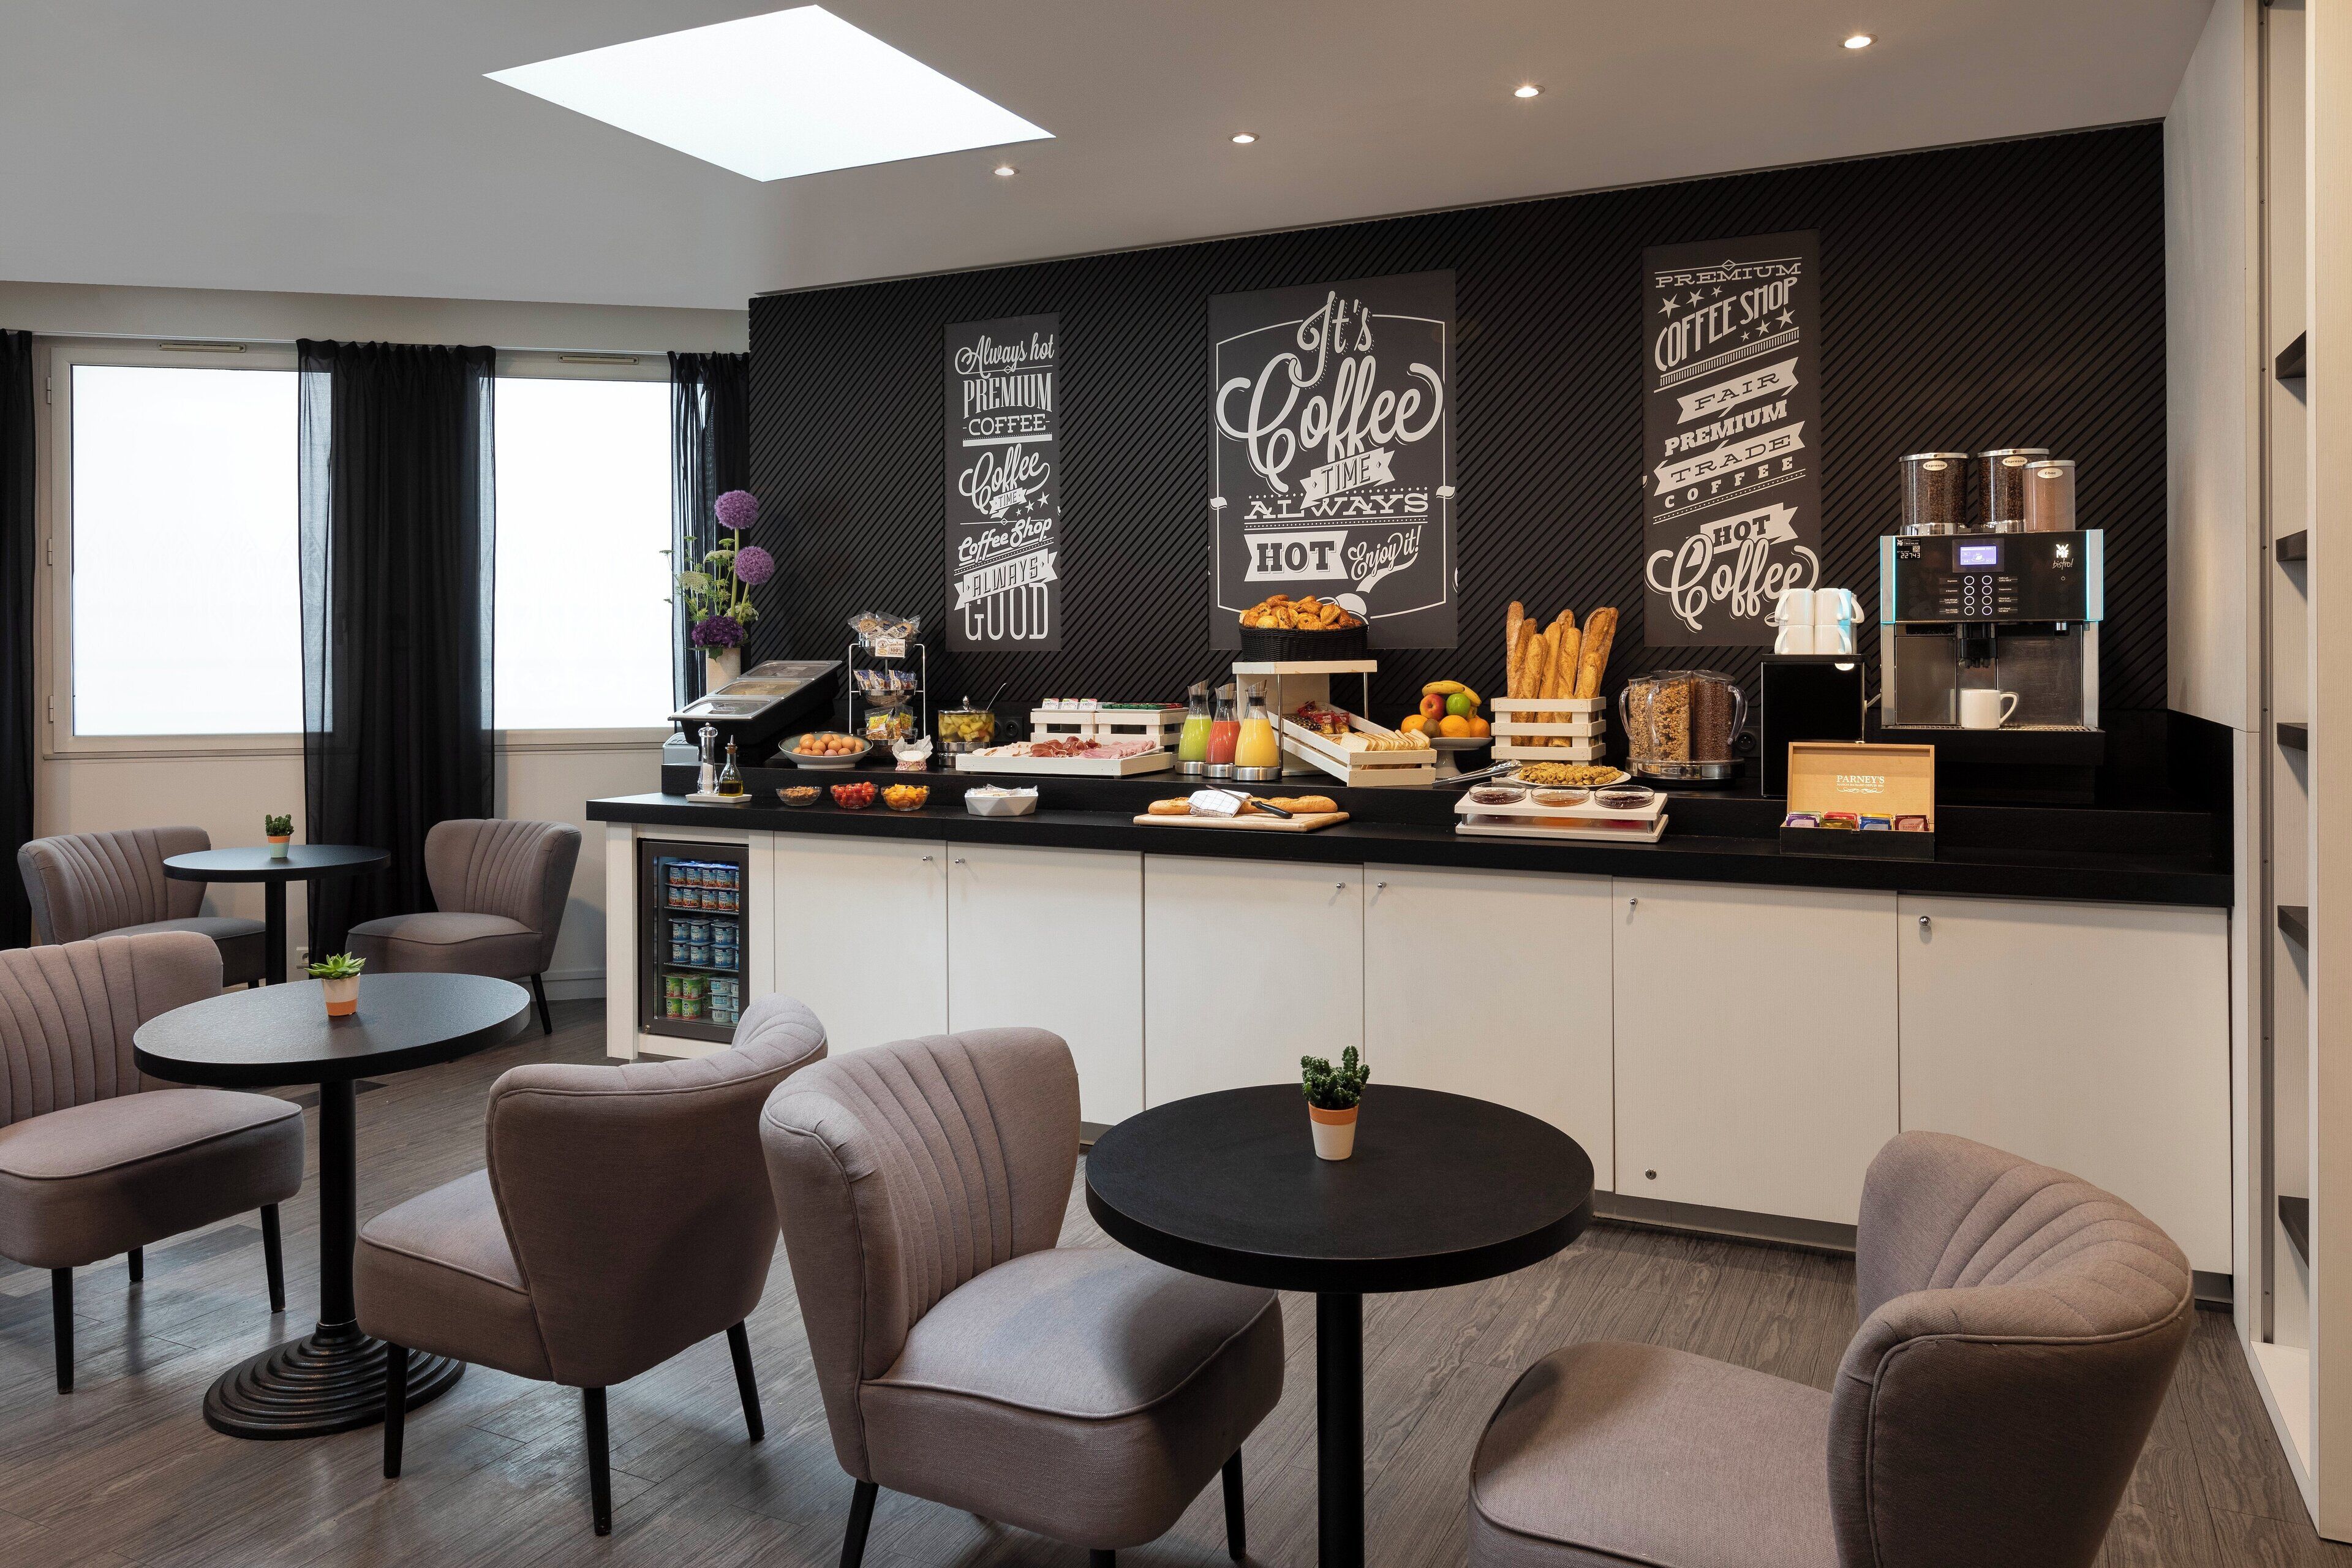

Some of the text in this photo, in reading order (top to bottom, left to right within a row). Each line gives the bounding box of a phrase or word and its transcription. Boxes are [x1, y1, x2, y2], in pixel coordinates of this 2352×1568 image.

[1656, 263, 1801, 288] PREMIUM
[1288, 290, 1374, 388] It's
[1654, 277, 1798, 372] COFFEE SHOP
[954, 332, 1055, 379] Always hot
[963, 372, 1052, 419] PREMIUM
[1694, 372, 1780, 412] FAIR
[968, 413, 1046, 435] COFFEE
[1215, 353, 1443, 494] Coffee
[1665, 399, 1787, 457] PREMIUM
[959, 443, 1050, 514] Coffee
[1321, 453, 1371, 494] TIME
[1664, 456, 1793, 508] COFFEE
[1671, 434, 1791, 483] TRADE
[998, 491, 1017, 508] TIME
[1244, 492, 1428, 519] ALWAYS
[958, 516, 1052, 564] Coffee Shop
[1256, 525, 1422, 581] HOT Enjoy it!
[1713, 514, 1771, 546] HOT
[2056, 543, 2069, 558] WMF
[973, 556, 1038, 598] ALWAYS
[1644, 533, 1819, 633] Coffee
[2052, 558, 2074, 570] bistro!
[965, 582, 1049, 641] GOOD
[1836, 775, 1885, 784] PARNEY'S
